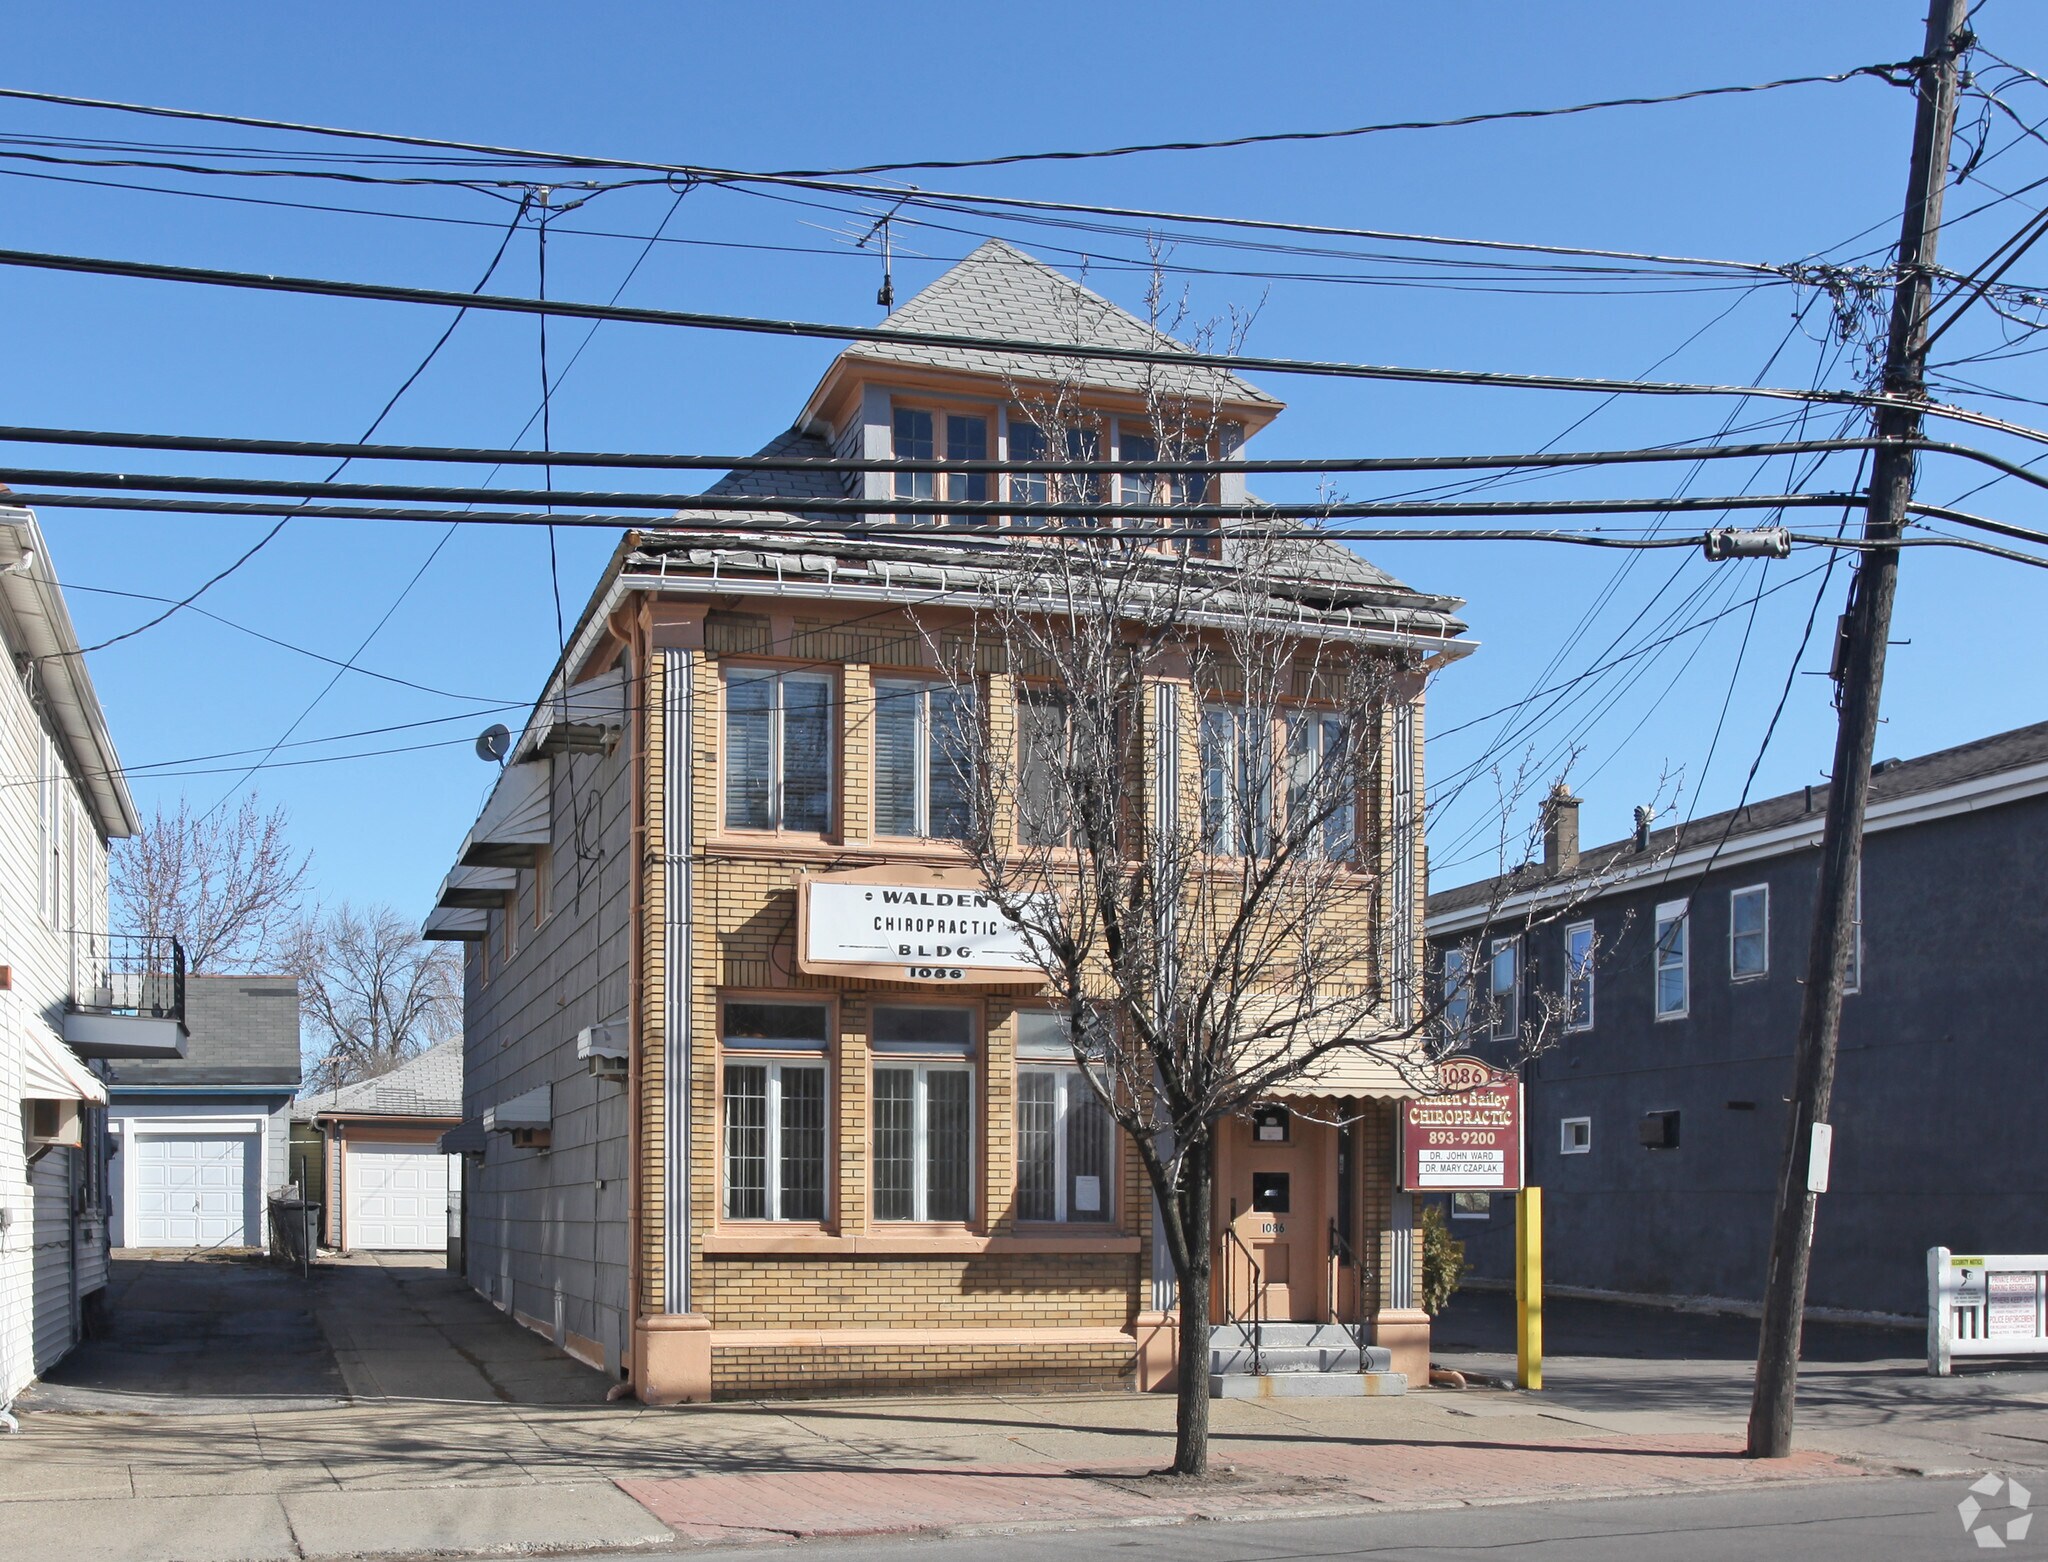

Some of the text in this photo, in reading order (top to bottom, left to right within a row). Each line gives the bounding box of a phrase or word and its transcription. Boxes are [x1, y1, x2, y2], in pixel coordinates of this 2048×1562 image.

[882, 891, 988, 908] WALDEN
[874, 916, 998, 936] CHIROPRACTIC
[898, 944, 976, 959] BLDG.
[910, 967, 963, 979] 1086
[1441, 1068, 1482, 1084] 1086
[1468, 1091, 1510, 1110] Bailey
[1409, 1107, 1513, 1126] CHIROPRACTIC
[1428, 1131, 1496, 1145] 893-9200
[1429, 1151, 1494, 1161] DR. JOHN WARD
[1425, 1163, 1498, 1173] DR. MARY CZAPLAK
[1262, 1223, 1285, 1233] 1086
[2011, 1296, 2023, 1304] KEEP
[2023, 1296, 2034, 1304] OUT
